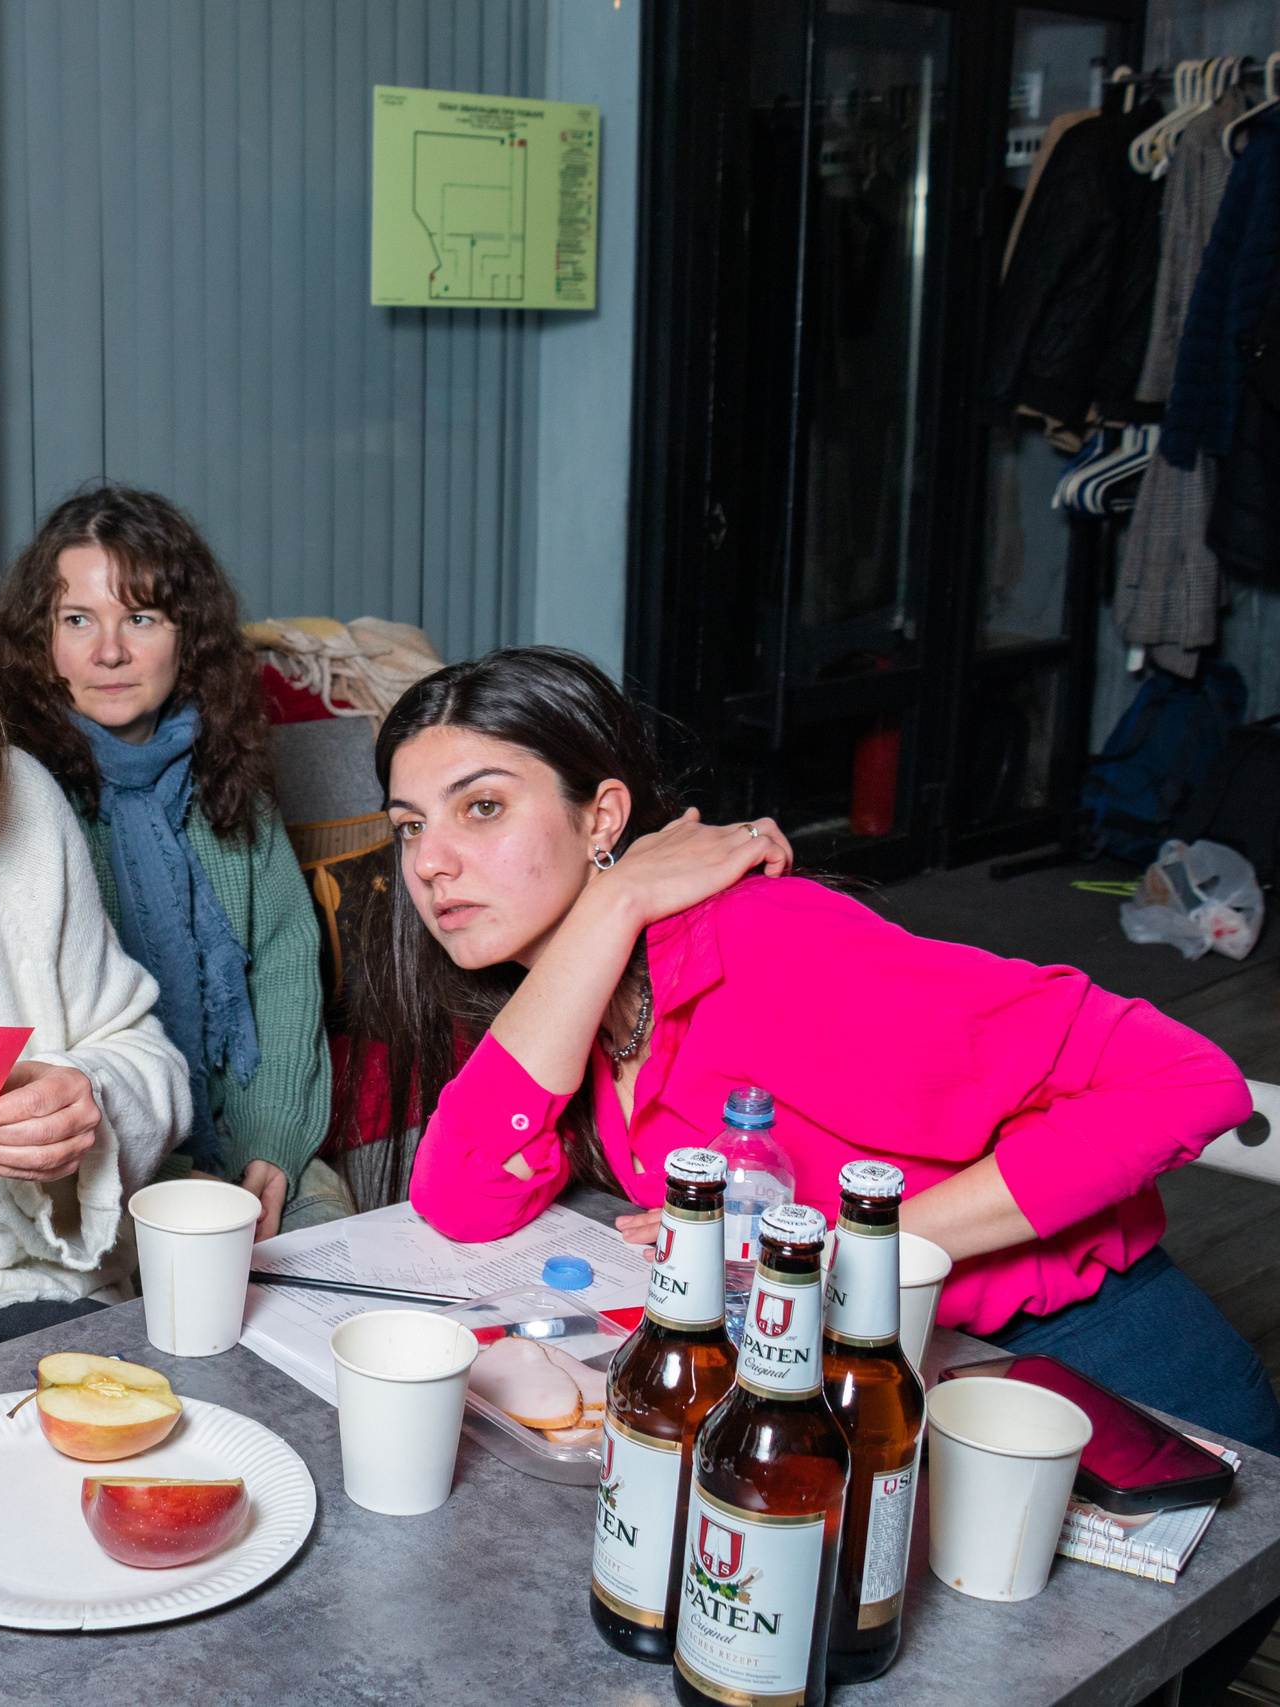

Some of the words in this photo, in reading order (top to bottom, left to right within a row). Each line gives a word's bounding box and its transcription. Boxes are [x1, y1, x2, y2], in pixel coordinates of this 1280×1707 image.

[651, 1269, 689, 1296] TEN
[758, 1321, 766, 1329] G
[773, 1325, 782, 1334] S
[744, 1356, 791, 1379] Original
[597, 1499, 639, 1548] TEN
[702, 1554, 711, 1565] G
[720, 1564, 730, 1575] S
[684, 1573, 782, 1636] PATEN
[690, 1612, 738, 1646] Original
[718, 1649, 761, 1668] REZEPT
